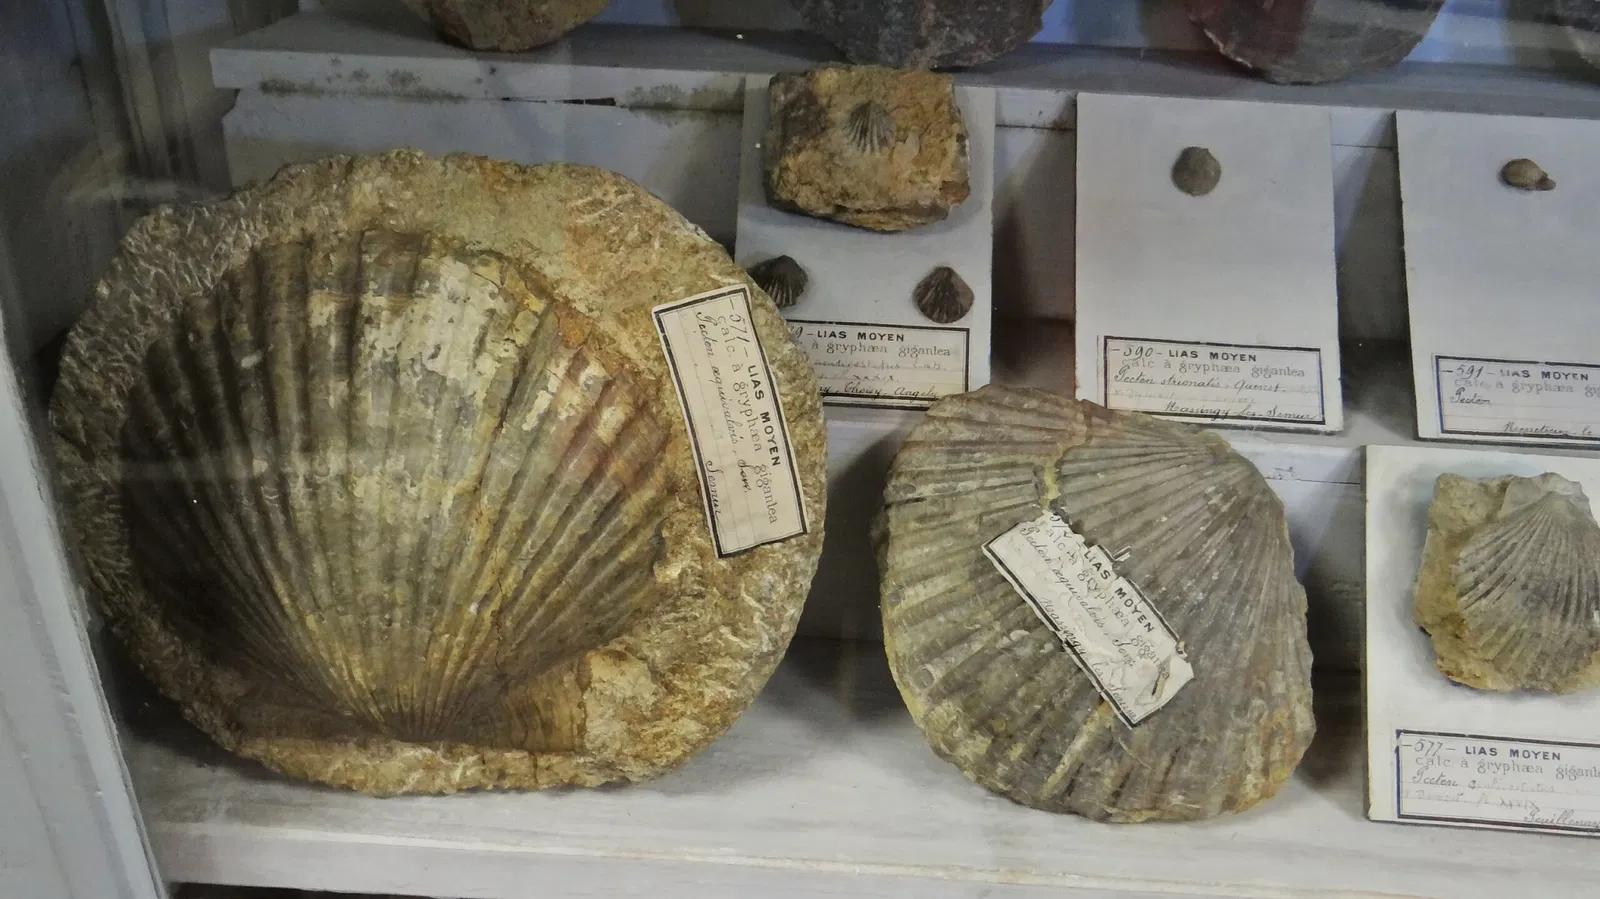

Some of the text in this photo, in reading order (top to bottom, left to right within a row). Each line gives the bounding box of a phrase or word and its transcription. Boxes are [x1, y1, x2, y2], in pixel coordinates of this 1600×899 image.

[817, 330, 847, 339] LIAS
[857, 332, 904, 342] MOYEN
[898, 344, 951, 359] gigantea
[1168, 349, 1198, 359] LIAS
[1209, 351, 1257, 362] MOYEN
[1250, 363, 1305, 379] gigantea
[1500, 369, 1531, 378] LIAS
[1541, 371, 1589, 381] MOYEN
[748, 365, 764, 400] LIAS
[760, 412, 780, 466] MOYEN
[732, 363, 744, 373] à
[753, 463, 778, 524] gigantea
[1083, 550, 1111, 580] LIAS
[1115, 587, 1154, 632] MOYEN
[1466, 746, 1497, 757] LIAS
[1509, 748, 1561, 760] MOYEN
[1460, 757, 1468, 768] à
